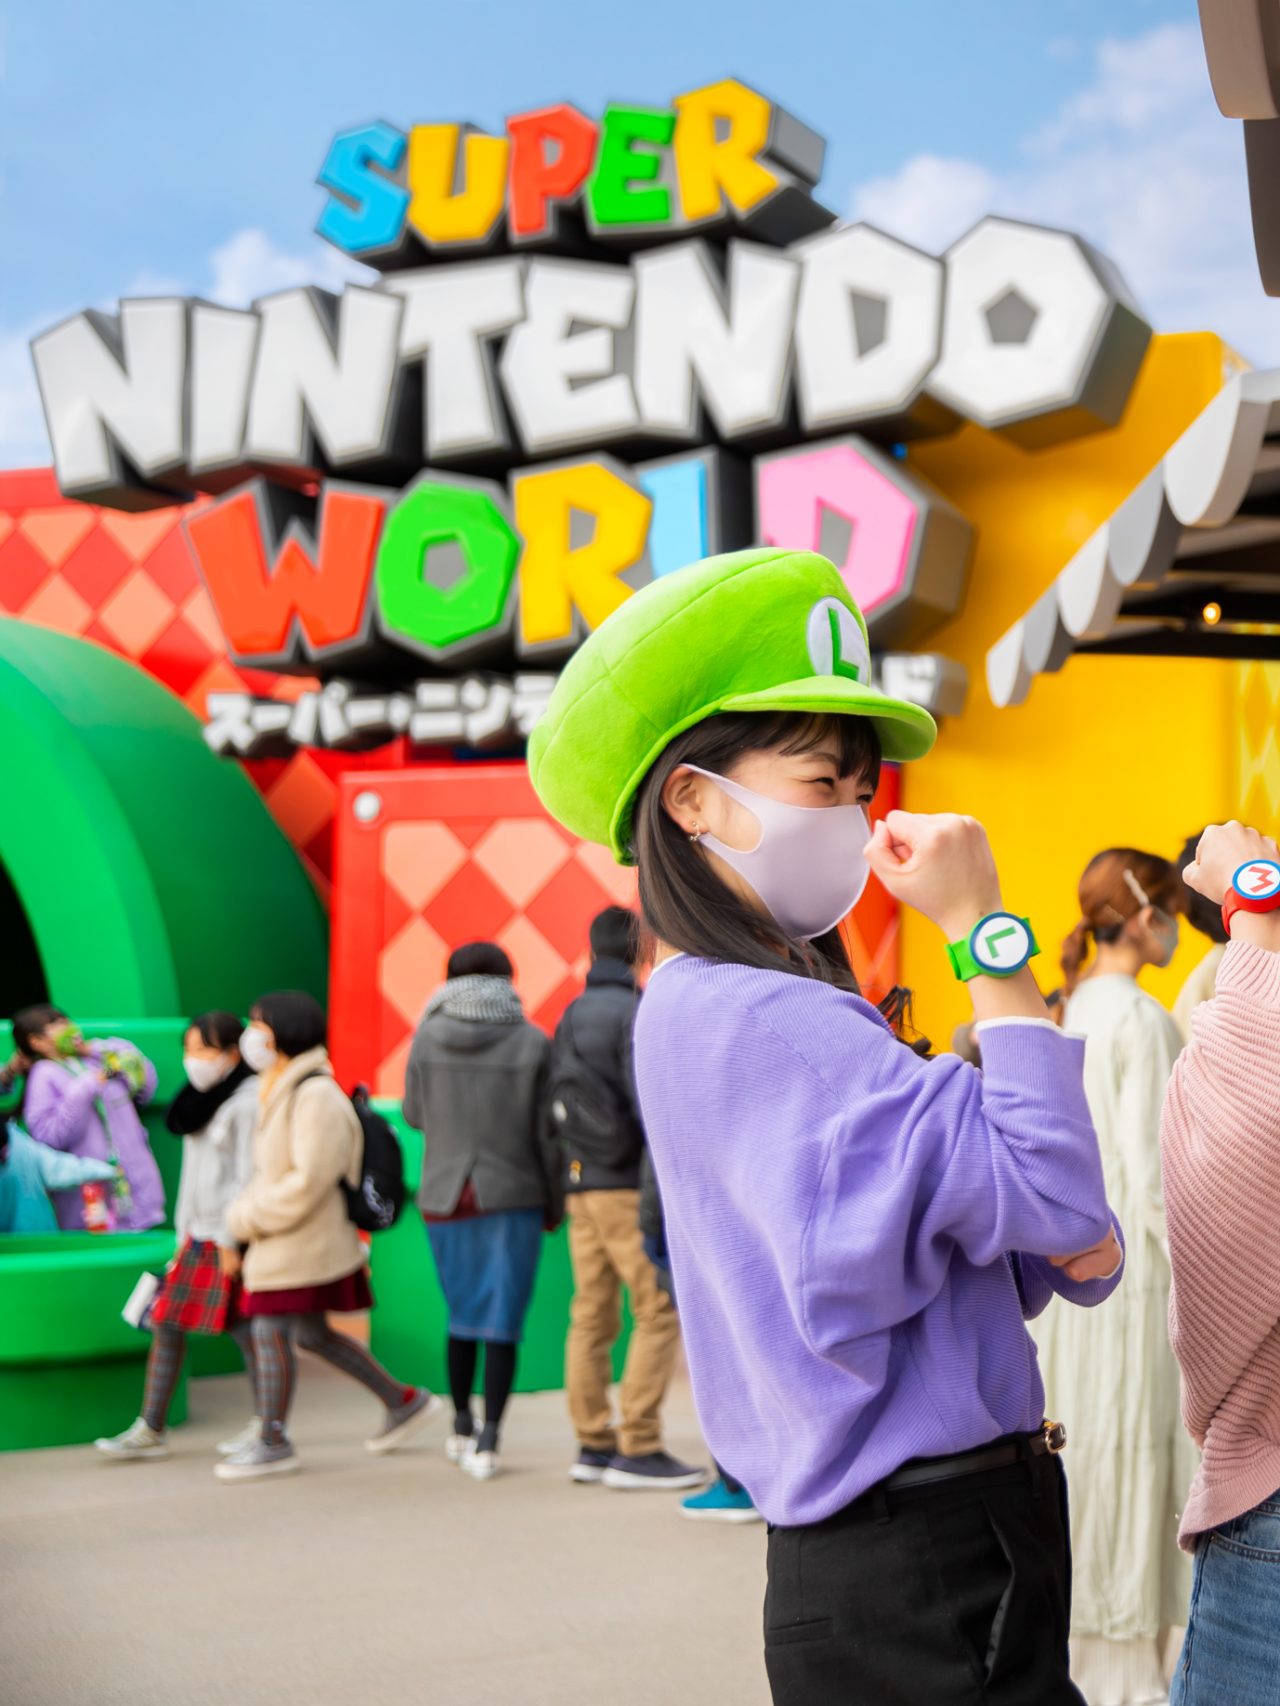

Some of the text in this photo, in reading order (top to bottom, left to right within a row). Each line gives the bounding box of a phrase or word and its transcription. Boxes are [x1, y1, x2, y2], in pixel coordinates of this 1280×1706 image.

[314, 76, 781, 256] SUPER
[30, 214, 1110, 500] NINTENDO
[827, 607, 860, 681] L
[1248, 866, 1275, 894] M
[984, 926, 1017, 959] L
